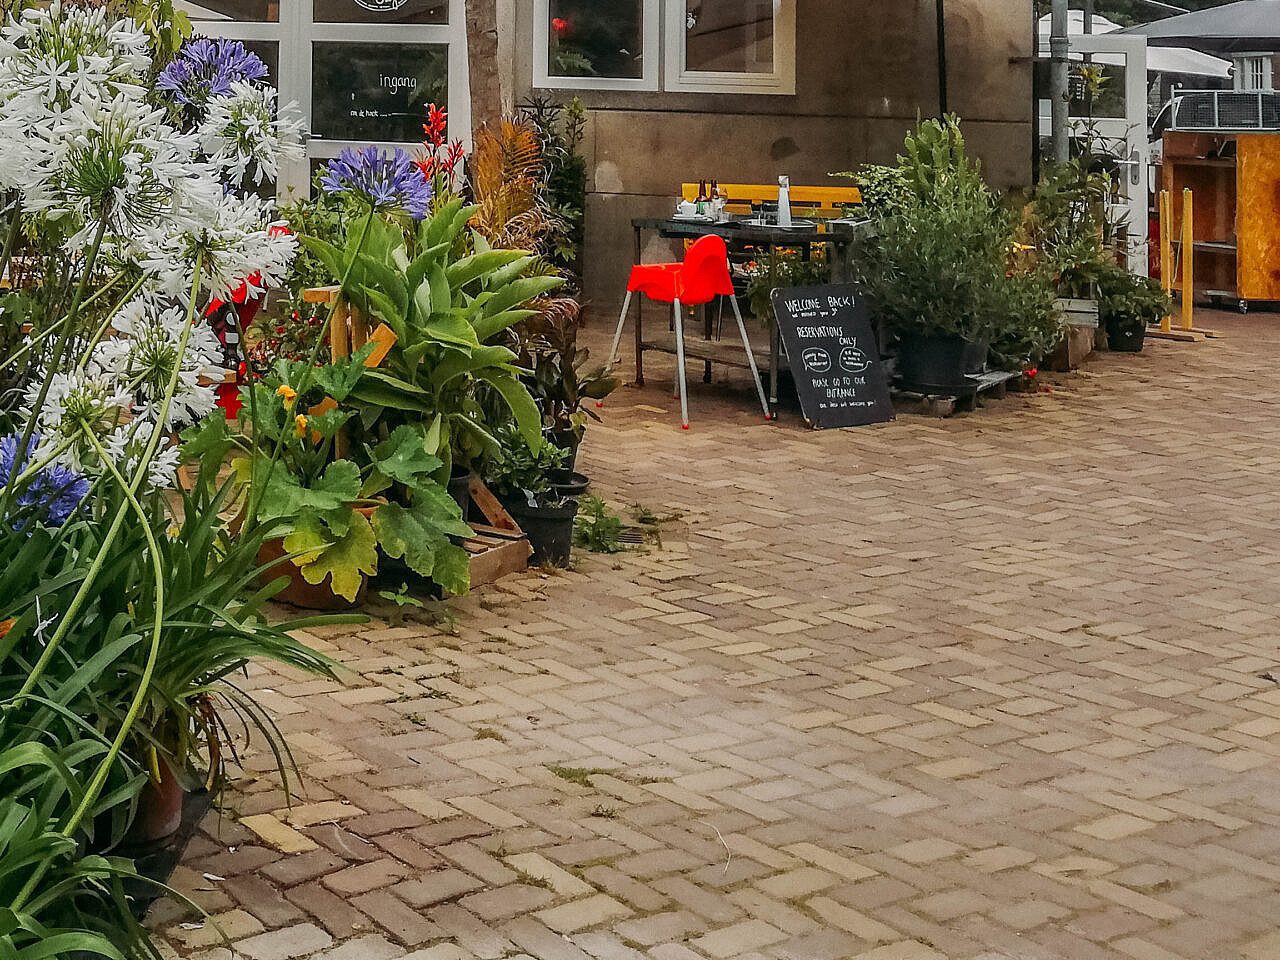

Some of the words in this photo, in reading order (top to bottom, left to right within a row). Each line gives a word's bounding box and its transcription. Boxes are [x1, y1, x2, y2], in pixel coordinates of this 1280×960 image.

[379, 73, 417, 95] ingang
[784, 298, 821, 313] WELCOME
[796, 326, 843, 338] RESERVATIONS
[838, 336, 857, 348] ONLY
[842, 376, 851, 386] TO
